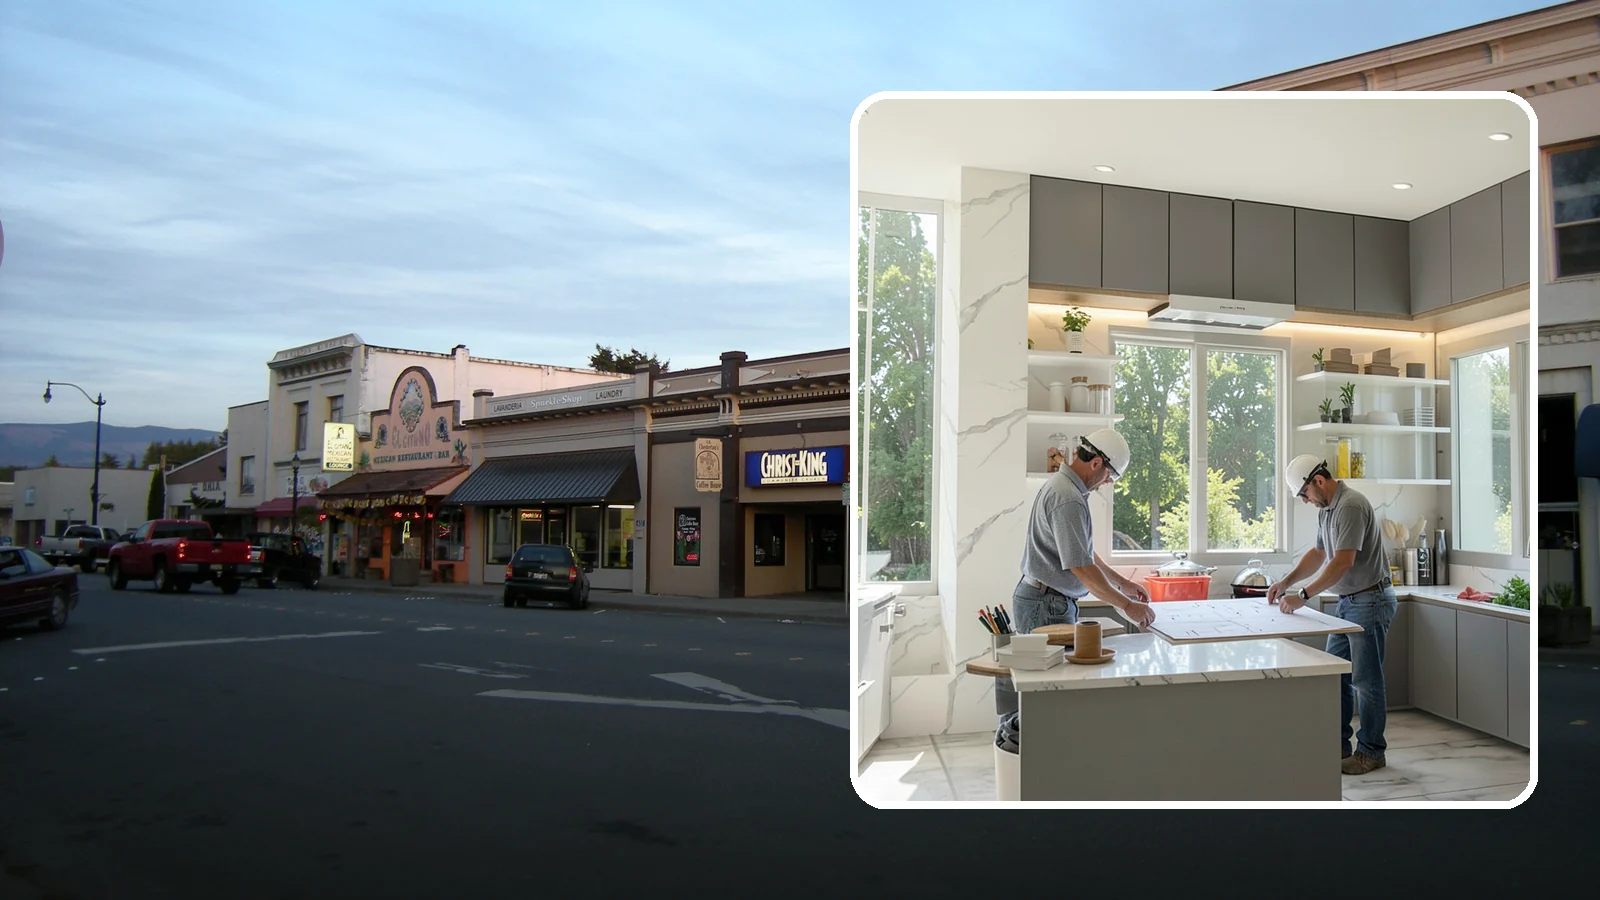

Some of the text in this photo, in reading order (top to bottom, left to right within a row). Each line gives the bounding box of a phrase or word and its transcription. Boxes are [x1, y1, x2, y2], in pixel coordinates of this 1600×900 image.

[595, 389, 623, 400] LAUNDRY
[493, 401, 522, 412] LAVANDERIA
[531, 395, 582, 408] Sparkle Shop
[373, 455, 396, 464] MEXICAN
[397, 451, 433, 462] RESTAURANT
[437, 450, 450, 459] BAR
[799, 450, 827, 476] KING
